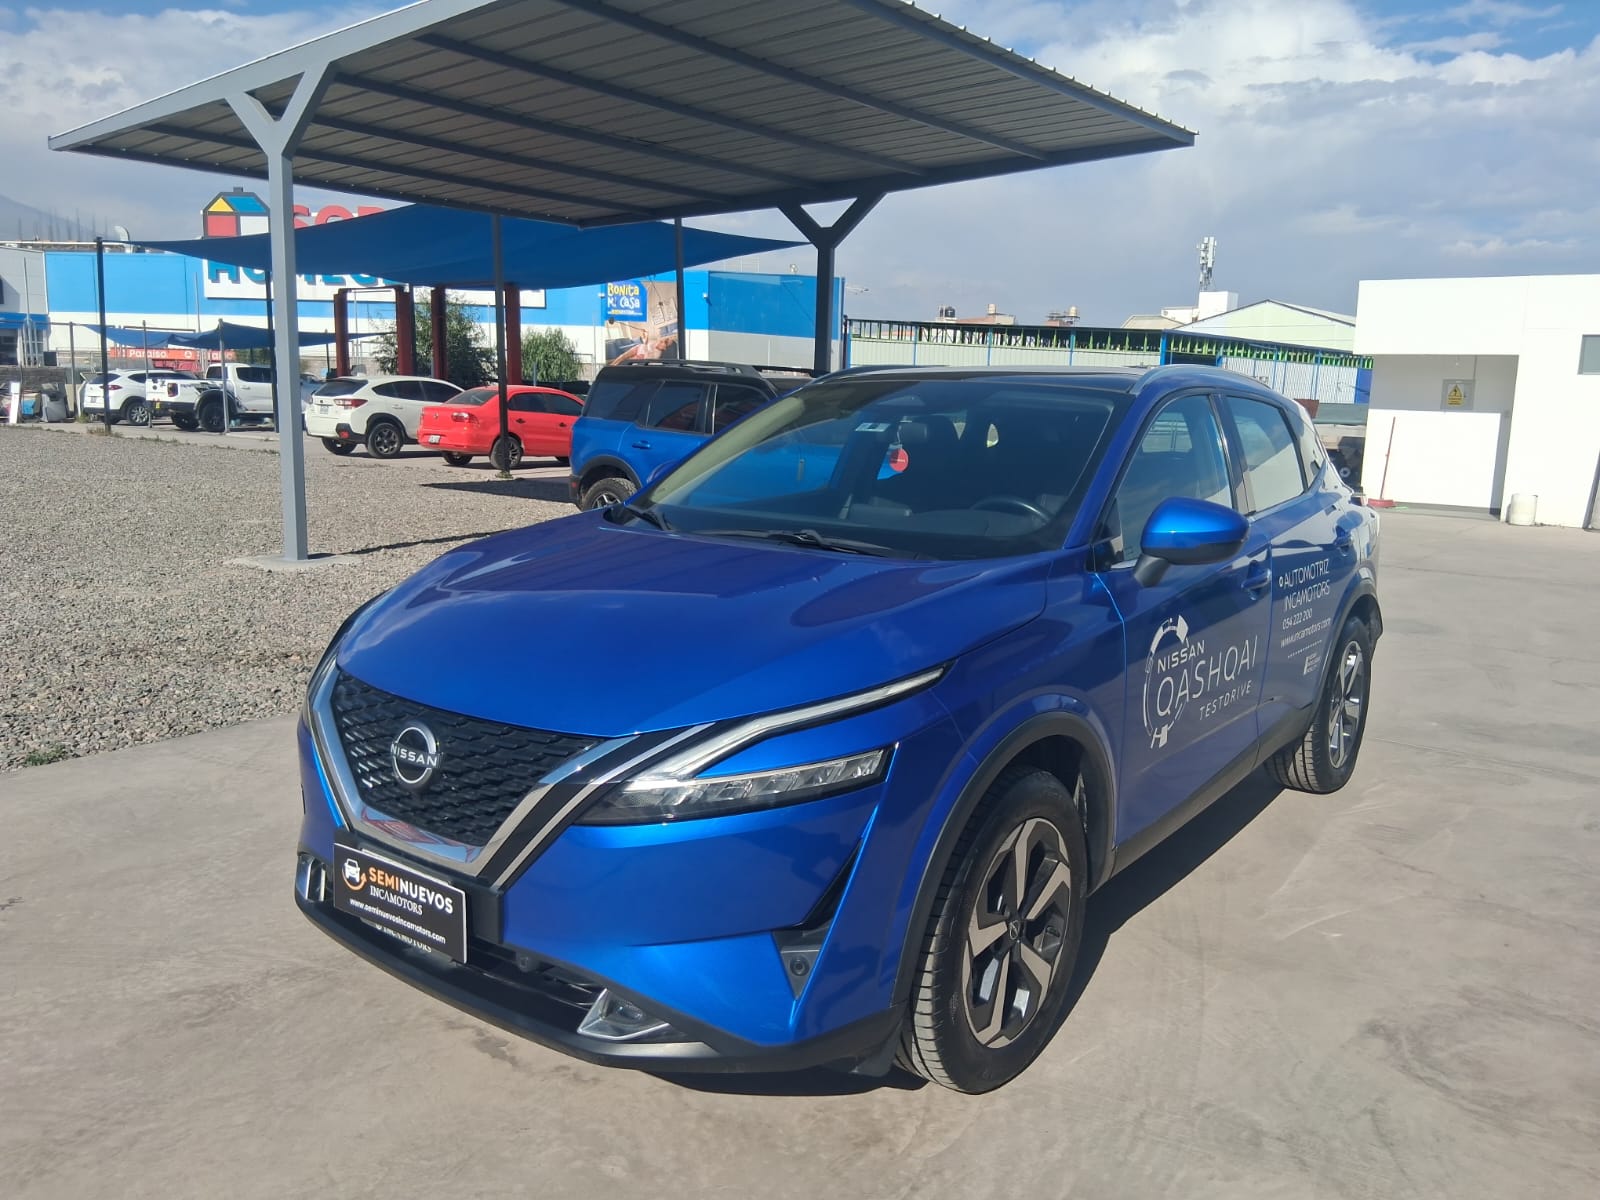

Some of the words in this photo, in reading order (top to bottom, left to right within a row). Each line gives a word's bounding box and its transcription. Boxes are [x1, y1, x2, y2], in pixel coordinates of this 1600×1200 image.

[1284, 558, 1330, 590] AUTOMOTRIZ
[1284, 579, 1331, 612] INCAMOTORS
[1293, 611, 1303, 626] 222
[1157, 639, 1205, 675] NISSAN
[1157, 634, 1258, 717] QASHQAI
[1199, 680, 1253, 720] TESTDRIVE
[390, 743, 438, 767] NISSAN
[368, 866, 454, 915] SEMINUEVOS
[369, 885, 424, 917] INCAMOTORS
[349, 898, 447, 945] www.seminuevosincamotors.com
